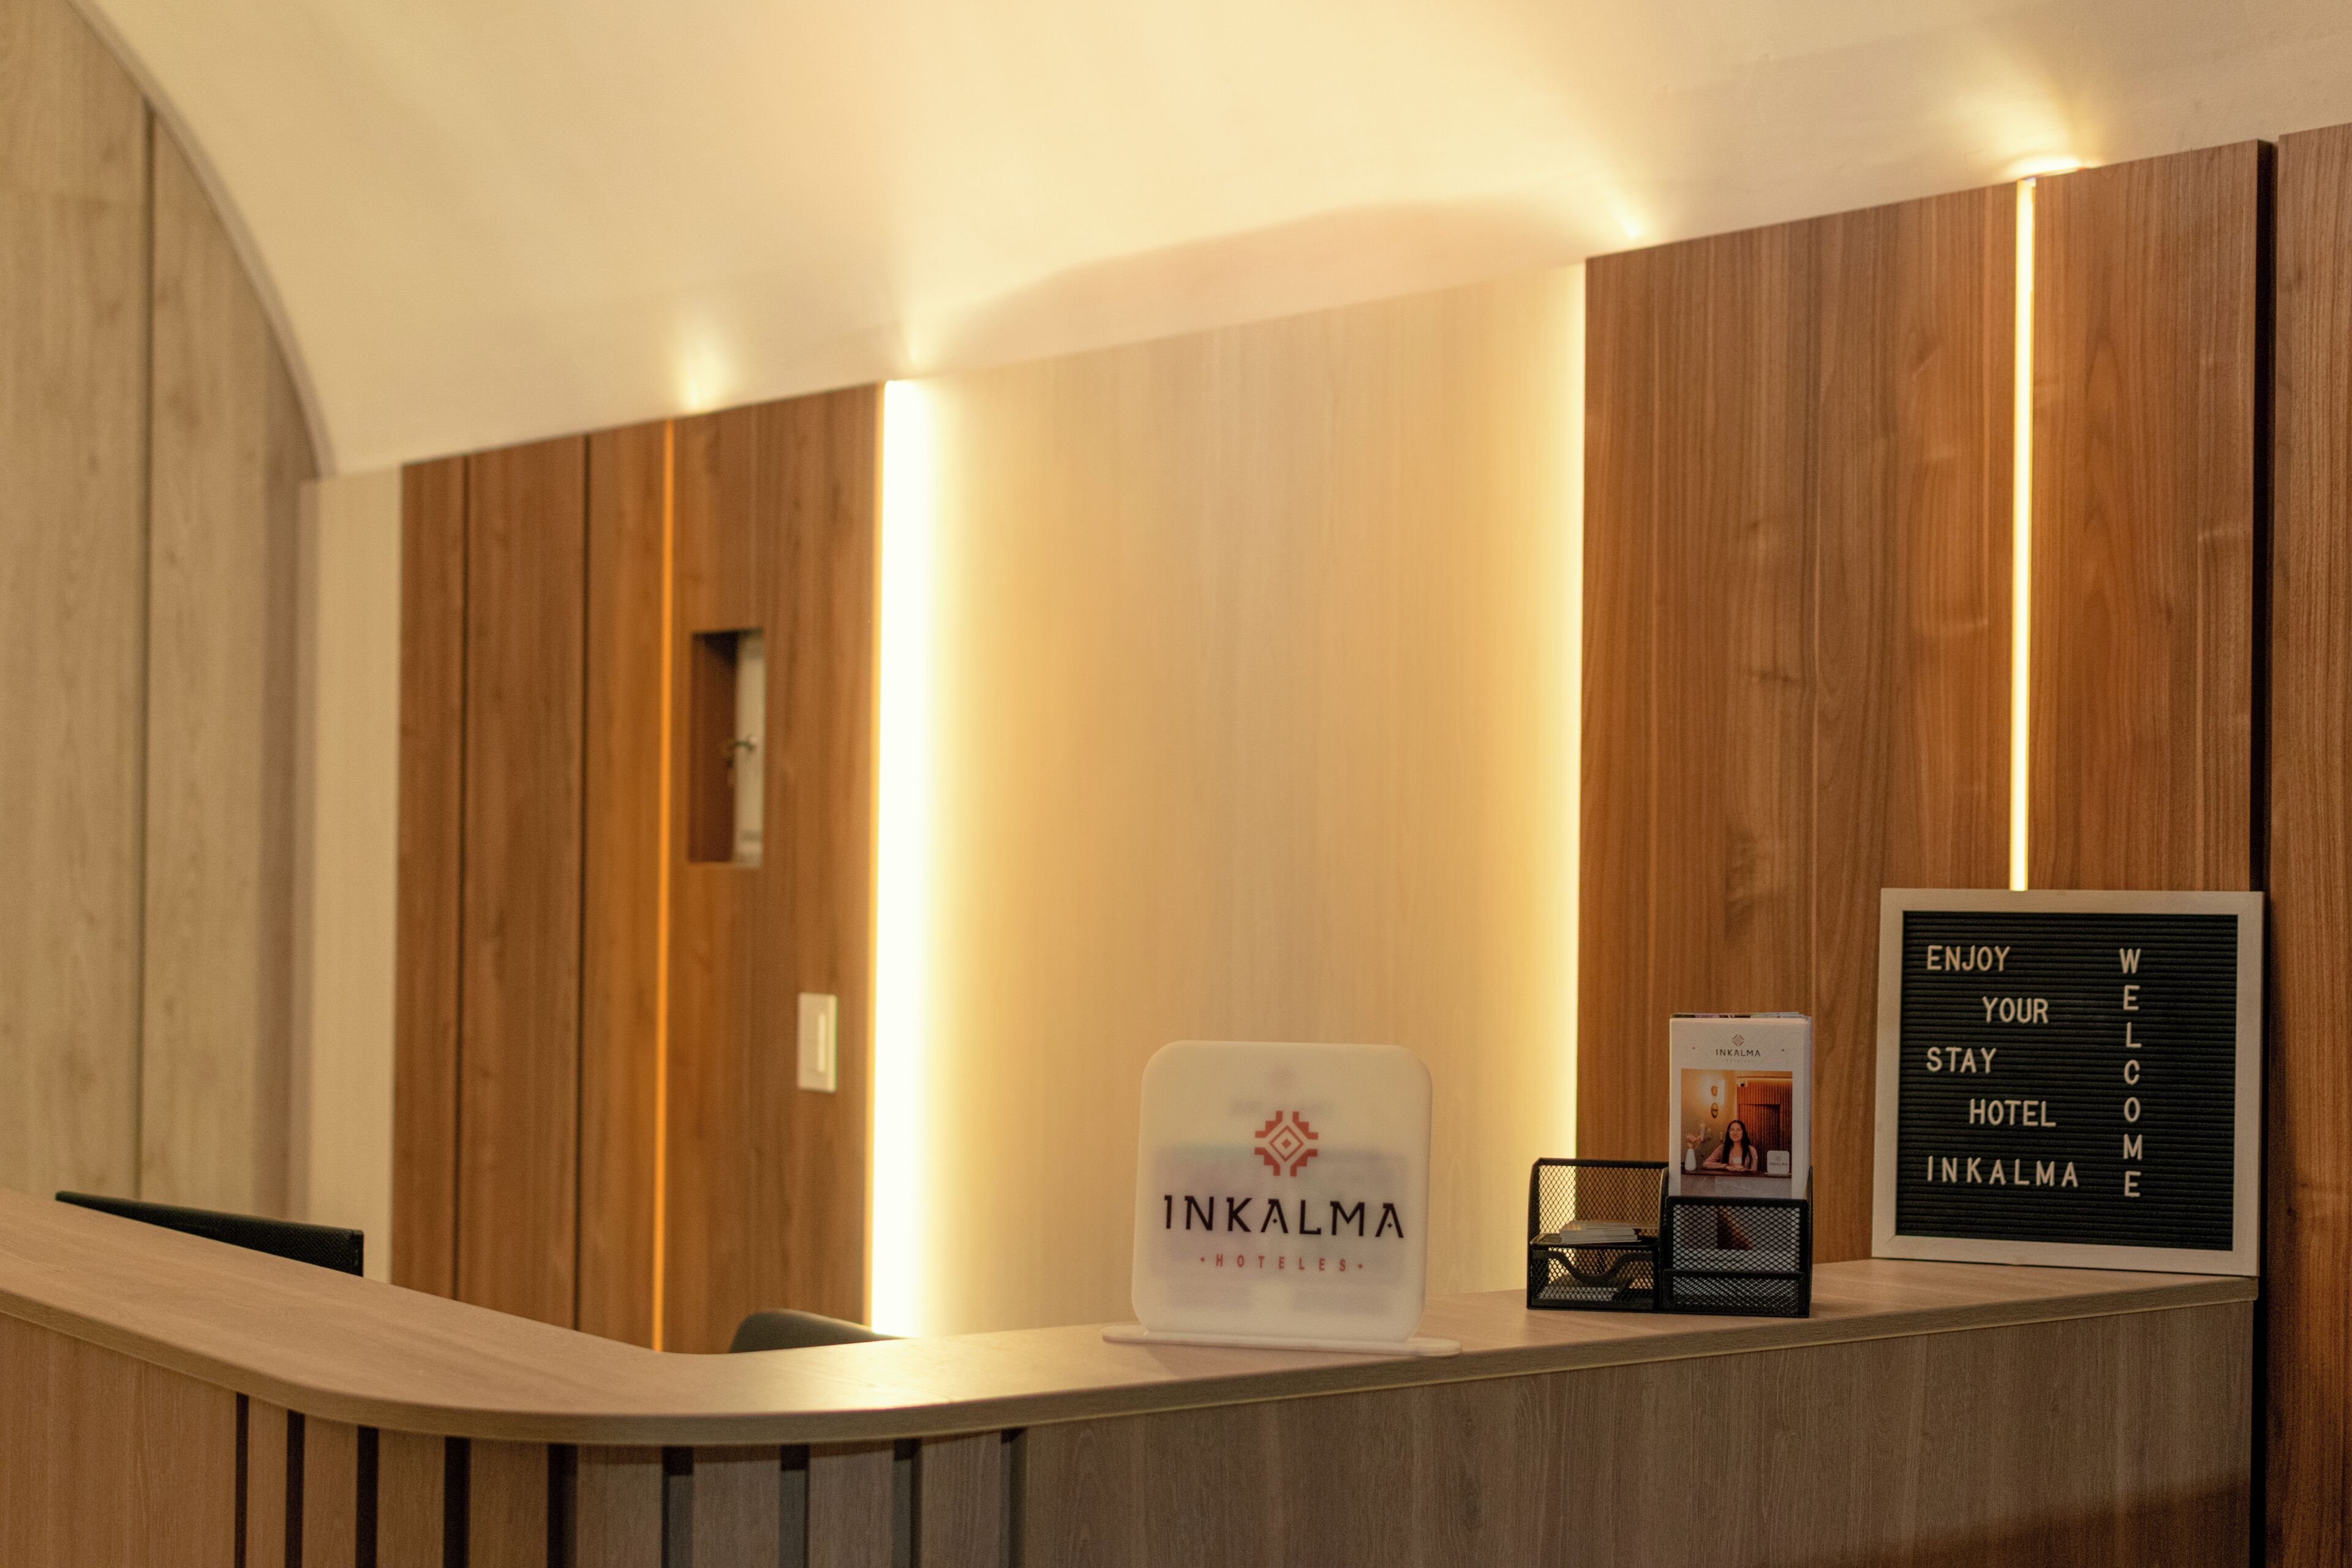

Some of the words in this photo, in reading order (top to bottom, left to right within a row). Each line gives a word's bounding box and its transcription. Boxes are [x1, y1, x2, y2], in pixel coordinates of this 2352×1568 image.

[1926, 944, 2011, 972] ENJOY
[1982, 996, 2049, 1024] YOUR
[1925, 1046, 1997, 1074] STAY
[2119, 947, 2143, 1197] WELCOME
[1968, 1098, 2057, 1128] HOTEL
[1926, 1155, 2079, 1188] INKALMA
[1164, 1194, 1404, 1239] INKALMA
